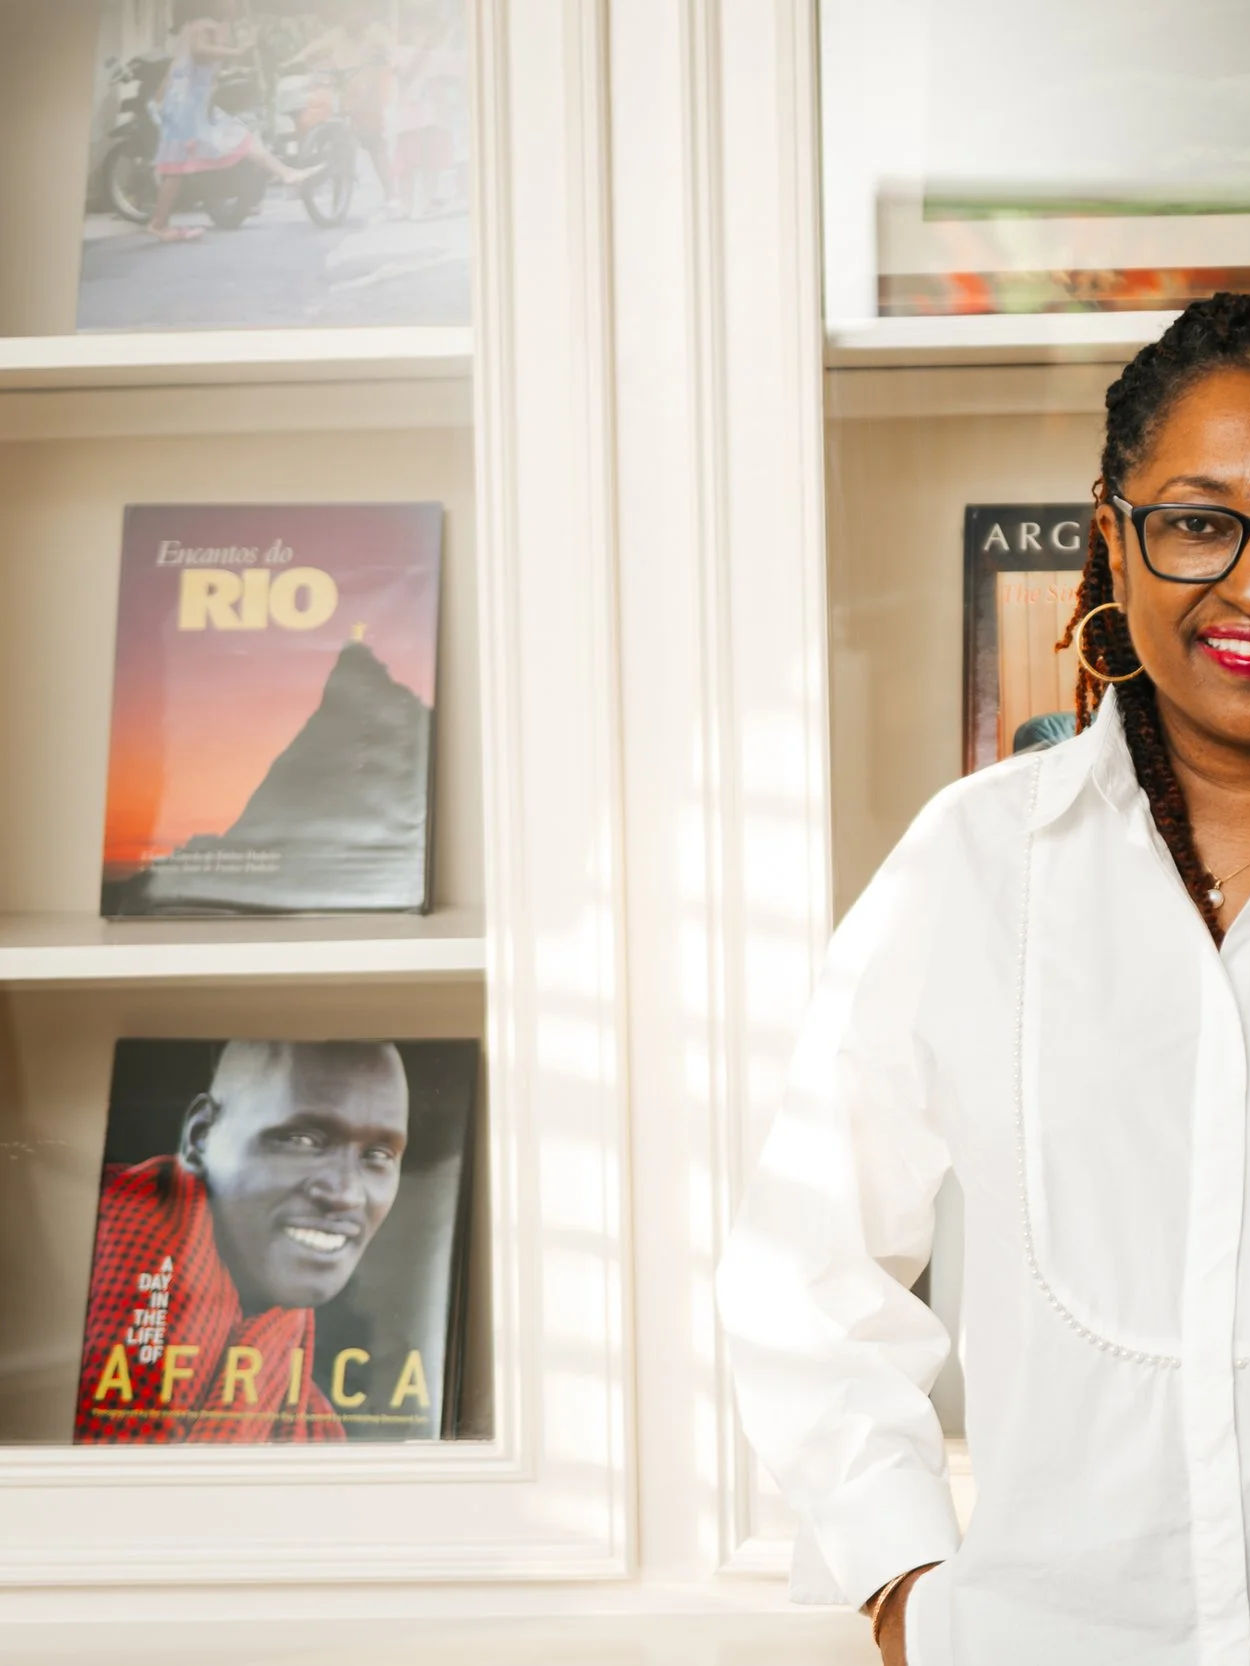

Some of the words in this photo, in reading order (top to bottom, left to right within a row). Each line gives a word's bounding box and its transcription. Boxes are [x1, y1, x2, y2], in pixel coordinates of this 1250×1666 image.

[155, 539, 258, 567] Encantos
[264, 538, 294, 564] do
[178, 566, 339, 631] RIO
[1003, 583, 1039, 603] The
[160, 1255, 173, 1272] A
[138, 1272, 173, 1292] DAY
[150, 1291, 170, 1308] IN
[133, 1308, 168, 1327] THE
[126, 1326, 165, 1346] LIFE
[138, 1345, 164, 1364] OF
[93, 1343, 431, 1408] AFRICA
